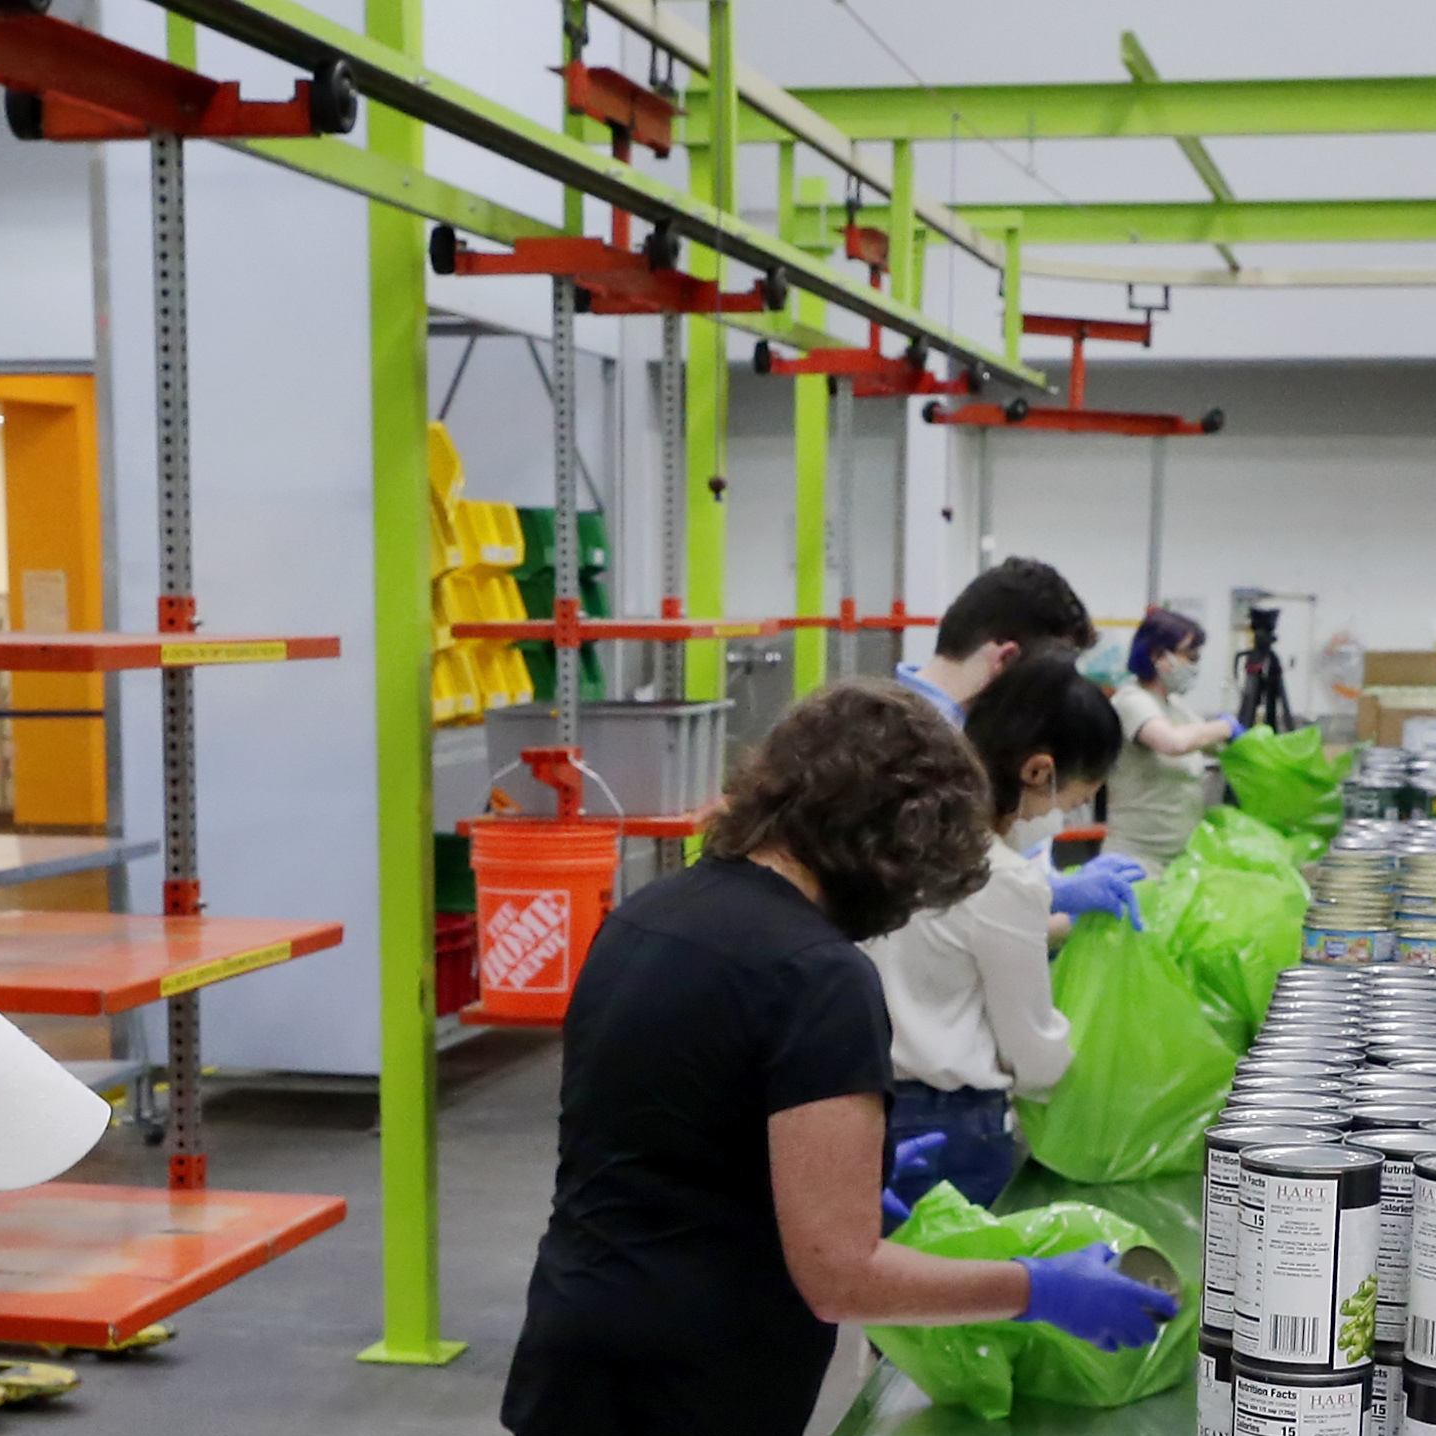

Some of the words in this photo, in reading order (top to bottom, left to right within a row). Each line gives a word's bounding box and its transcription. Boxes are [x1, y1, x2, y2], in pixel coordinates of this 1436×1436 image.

[481, 892, 562, 989] HOME
[1276, 1185, 1329, 1199] HART
[1253, 1214, 1265, 1227] 15
[1269, 1388, 1298, 1401] Facts
[1310, 1392, 1357, 1406] HART
[1372, 1403, 1387, 1415] 15
